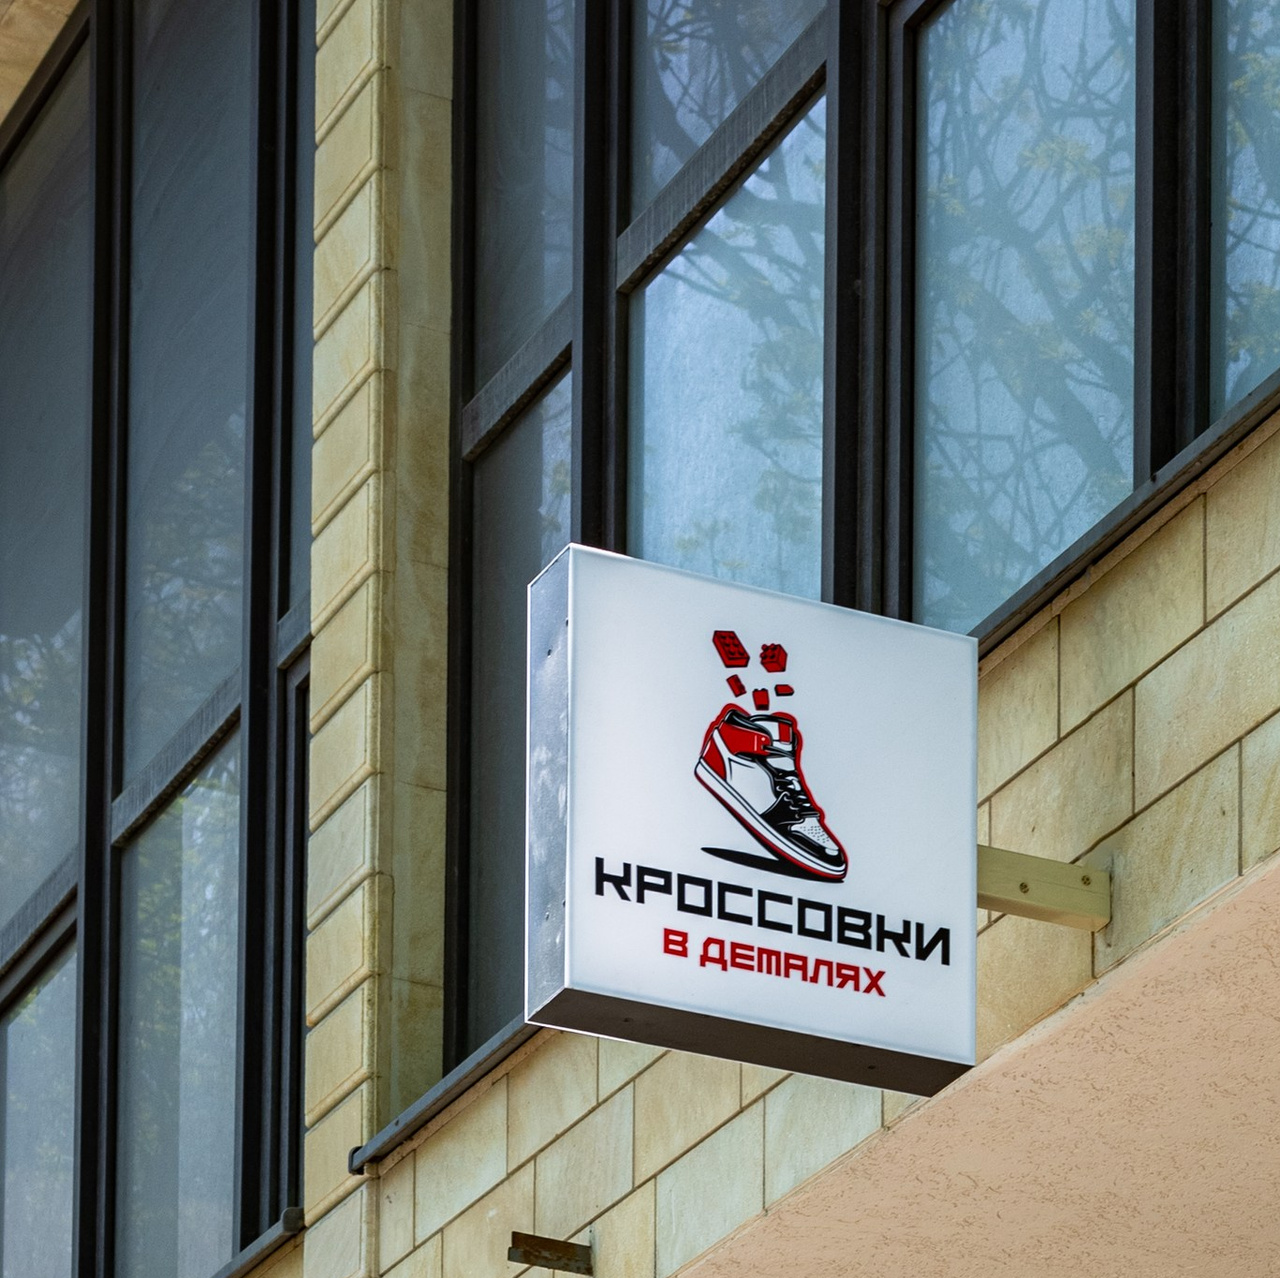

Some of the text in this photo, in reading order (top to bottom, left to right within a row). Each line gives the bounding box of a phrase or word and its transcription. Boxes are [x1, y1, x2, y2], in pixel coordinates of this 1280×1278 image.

[594, 856, 951, 966] КРОССОВКИ
[663, 928, 887, 997] В ДЕТАЛЯХ
